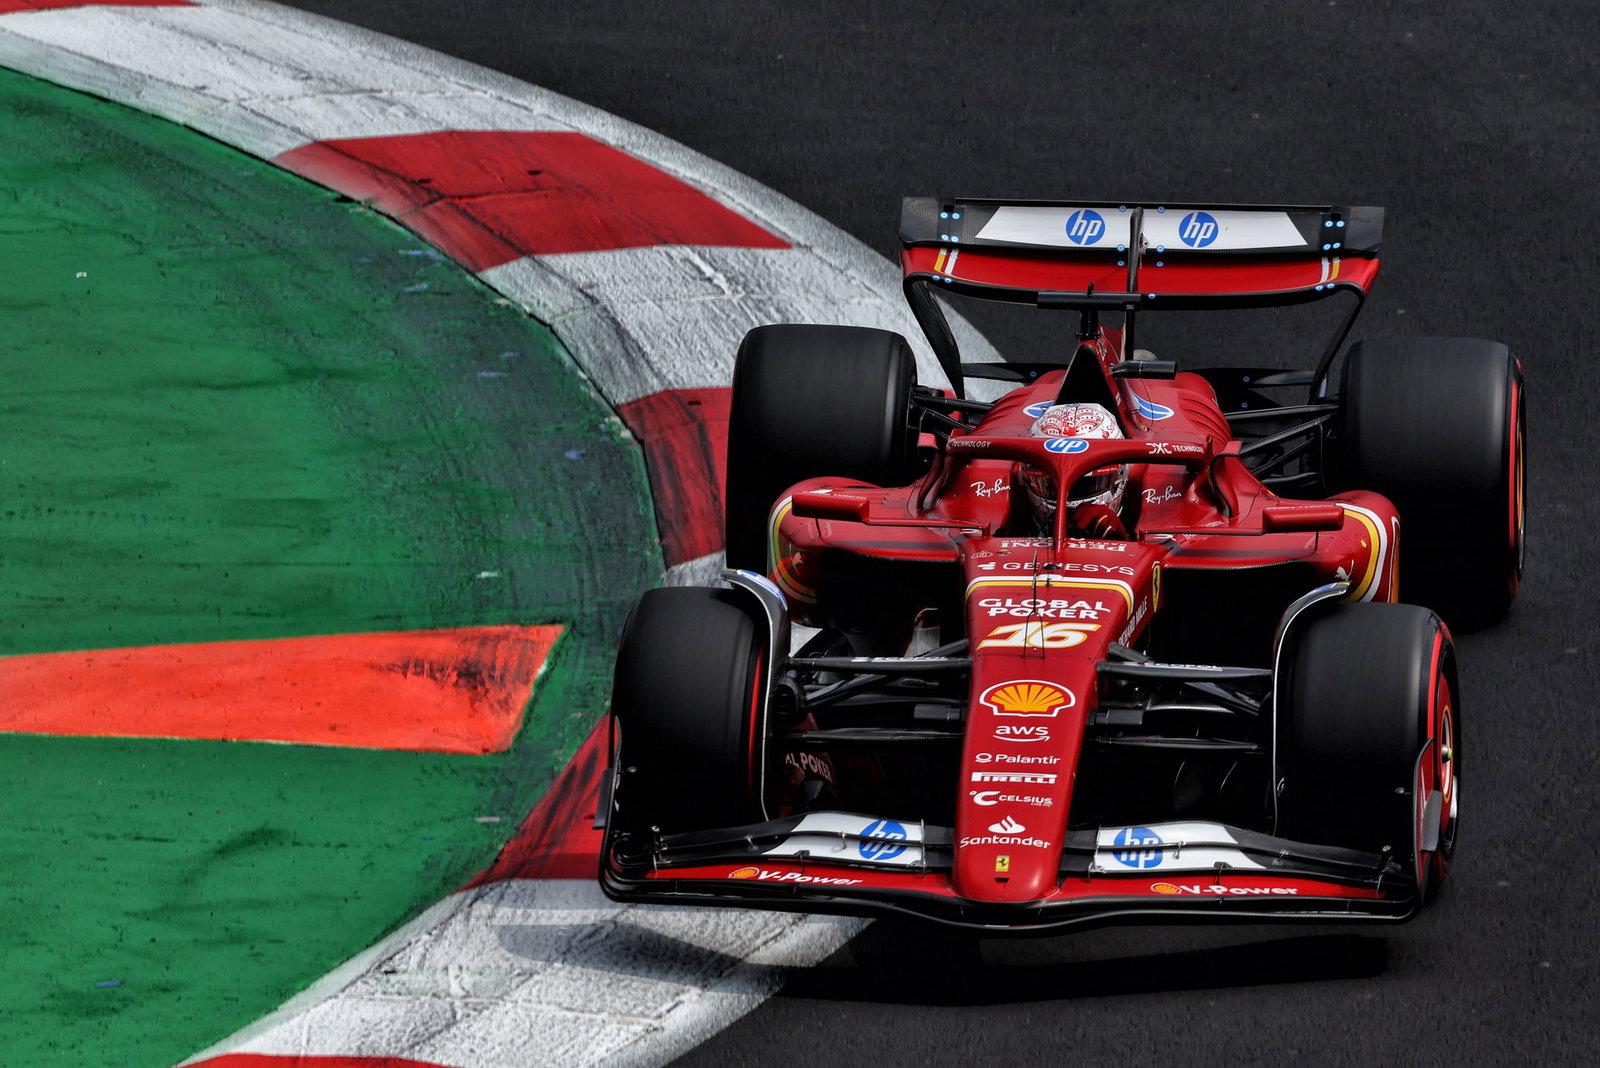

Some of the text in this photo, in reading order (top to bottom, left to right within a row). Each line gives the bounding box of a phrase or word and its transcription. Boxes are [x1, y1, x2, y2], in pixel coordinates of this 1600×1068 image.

[1069, 209, 1103, 245] hp
[1182, 212, 1216, 247] hp
[1049, 438, 1085, 453] hp
[970, 478, 1011, 497] Ray-Ban
[1141, 486, 1182, 504] Ray-Ban
[1002, 562, 1135, 576] GENESYS
[978, 598, 1111, 613] GLOBAL
[987, 607, 1099, 619] POKER
[976, 620, 1102, 650] 16
[995, 725, 1050, 736] aws
[995, 753, 1061, 765] Palantir
[971, 771, 1058, 784] PIRELLI
[998, 794, 1053, 804] CELSIUS
[862, 819, 905, 860] hp
[959, 834, 1051, 849] Santander
[1120, 827, 1159, 868] hp
[757, 870, 863, 885] V-Power
[1179, 884, 1298, 895] V-Power
